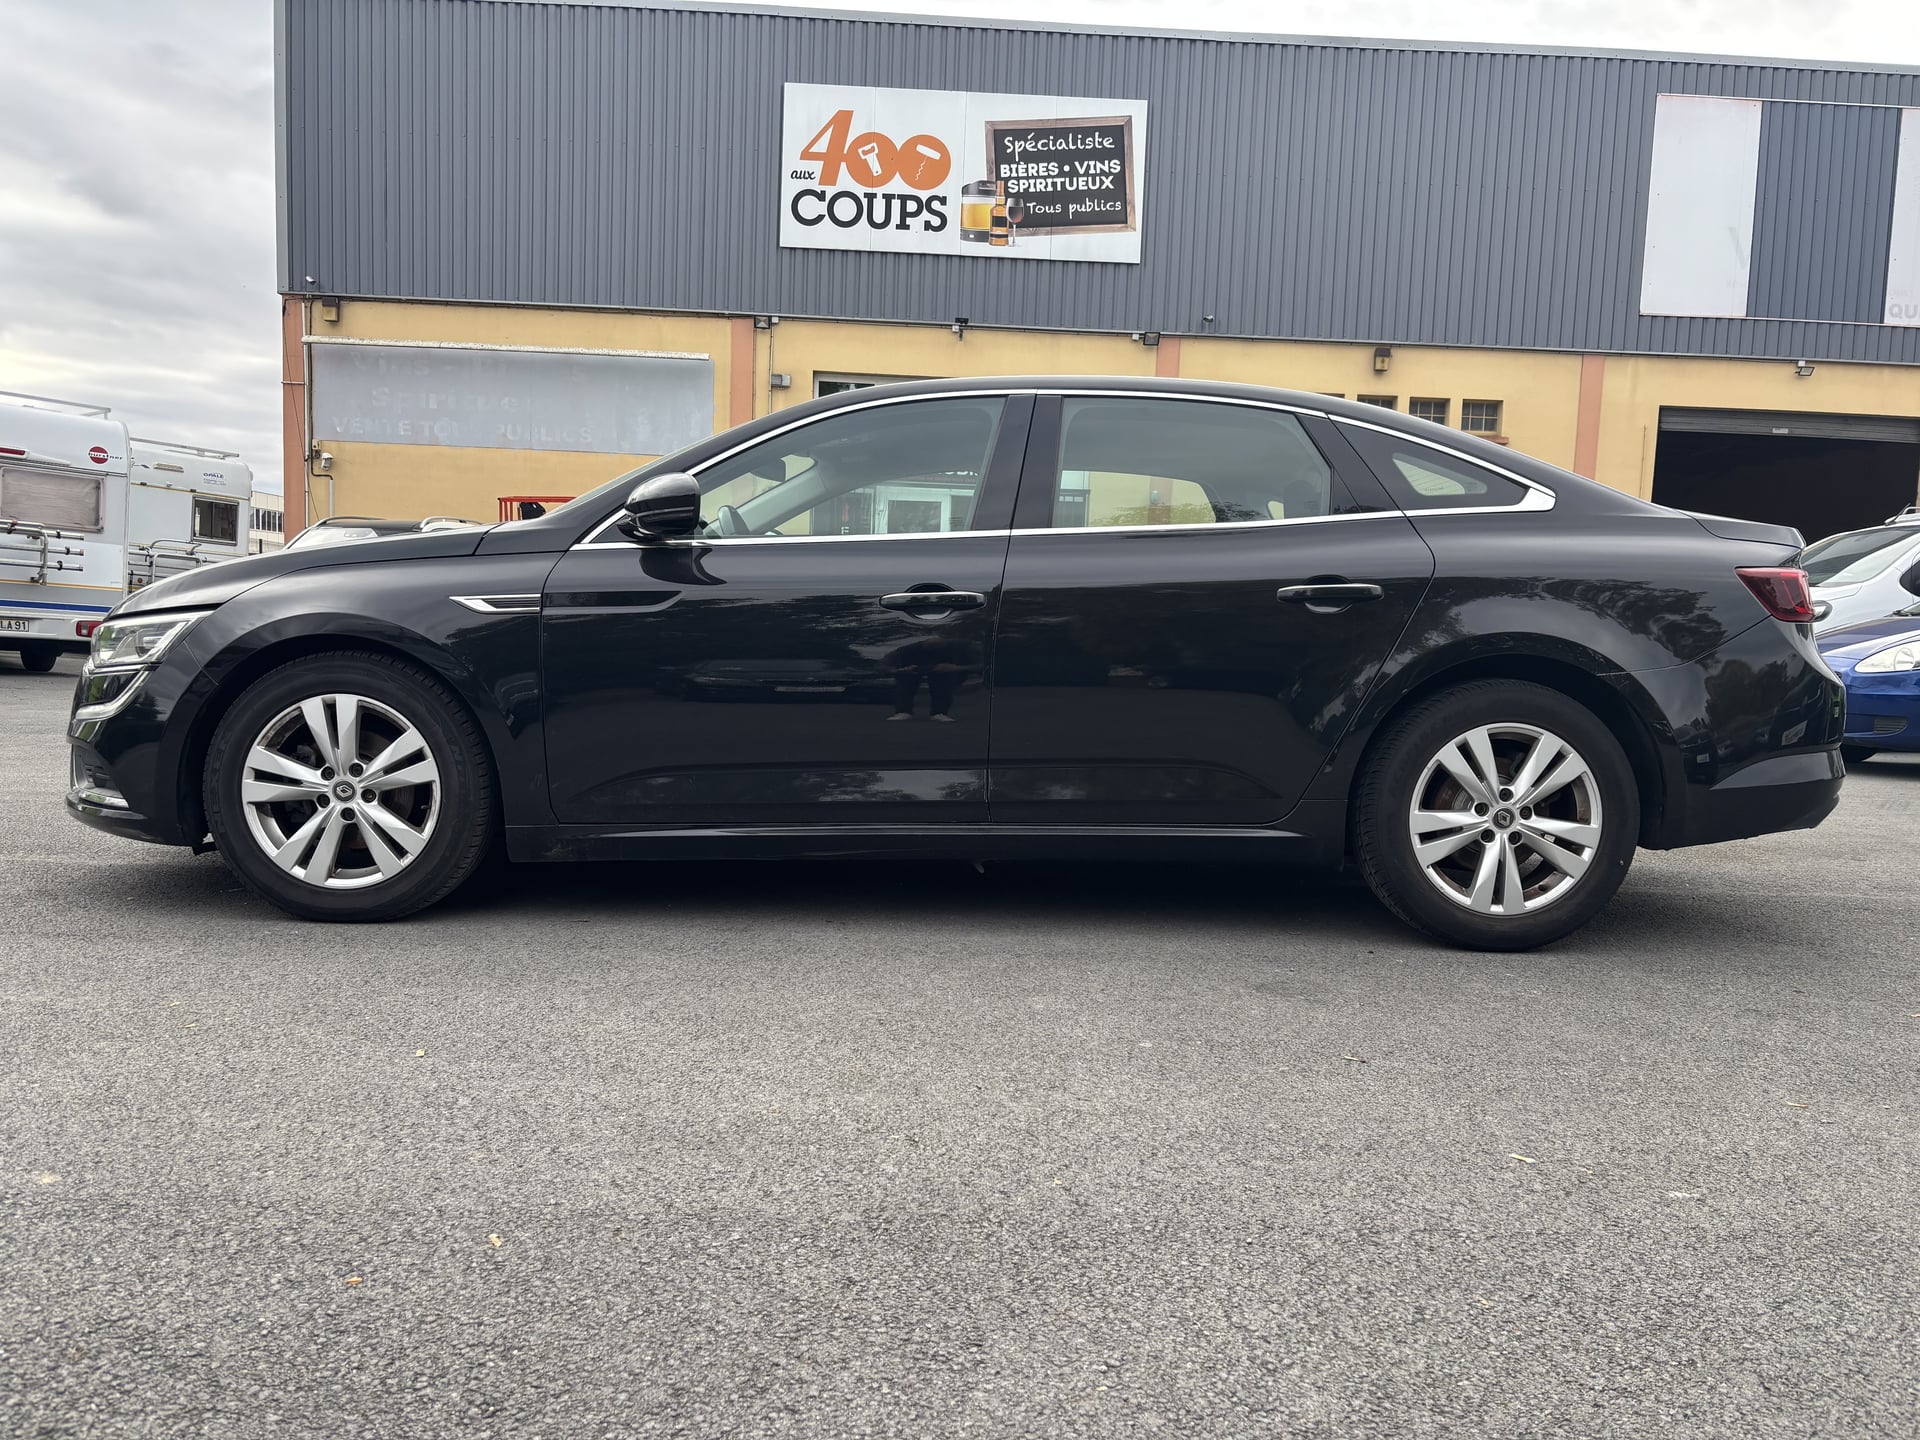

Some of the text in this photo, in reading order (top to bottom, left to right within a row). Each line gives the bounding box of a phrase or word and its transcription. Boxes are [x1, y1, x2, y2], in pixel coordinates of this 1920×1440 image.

[790, 109, 951, 190] aux 400
[1004, 131, 1115, 162] Spécialiste
[1000, 159, 1121, 178] BIÈRES VINS
[1007, 175, 1114, 193] SPIRITUEUX
[791, 188, 948, 232] COUPS
[1026, 197, 1122, 219] Tous publics
[1888, 304, 1920, 320] QU
